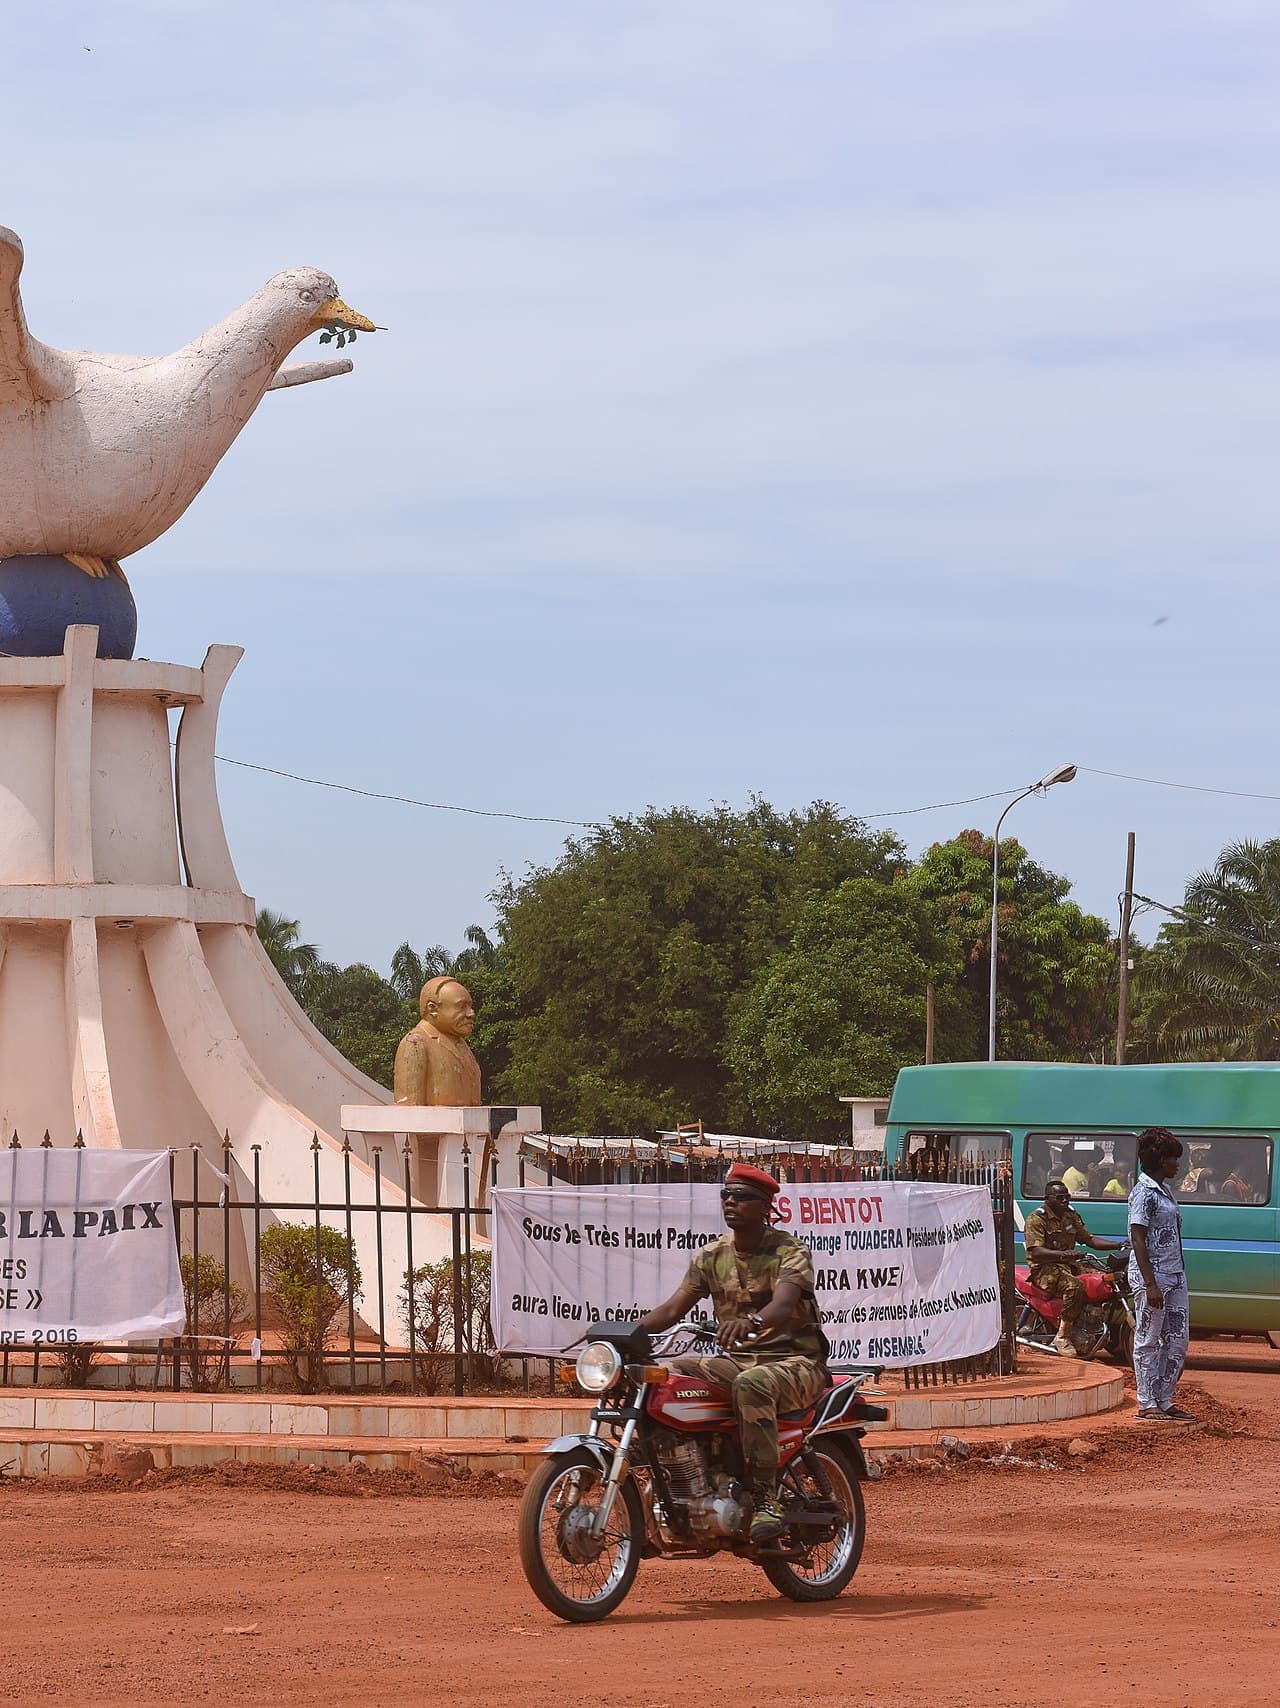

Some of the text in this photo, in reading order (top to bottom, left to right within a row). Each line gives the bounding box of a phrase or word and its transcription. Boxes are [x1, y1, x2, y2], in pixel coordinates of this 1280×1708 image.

[17, 1209, 66, 1239] LA
[72, 1201, 165, 1239] PAIX
[799, 1196, 883, 1225] BIENTOT
[522, 1216, 562, 1243] Sous
[584, 1224, 620, 1248] Très
[623, 1226, 663, 1250] Haut
[666, 1227, 725, 1250] Patron
[844, 1228, 904, 1252] TOUADERA
[906, 1226, 938, 1249] Président
[814, 1268, 852, 1291] ARA
[511, 1294, 548, 1316] aura
[552, 1295, 583, 1321] lieu
[586, 1301, 600, 1323] la
[850, 1303, 867, 1323] les
[868, 1303, 908, 1322] avenues
[31, 1328, 78, 1344] 2016
